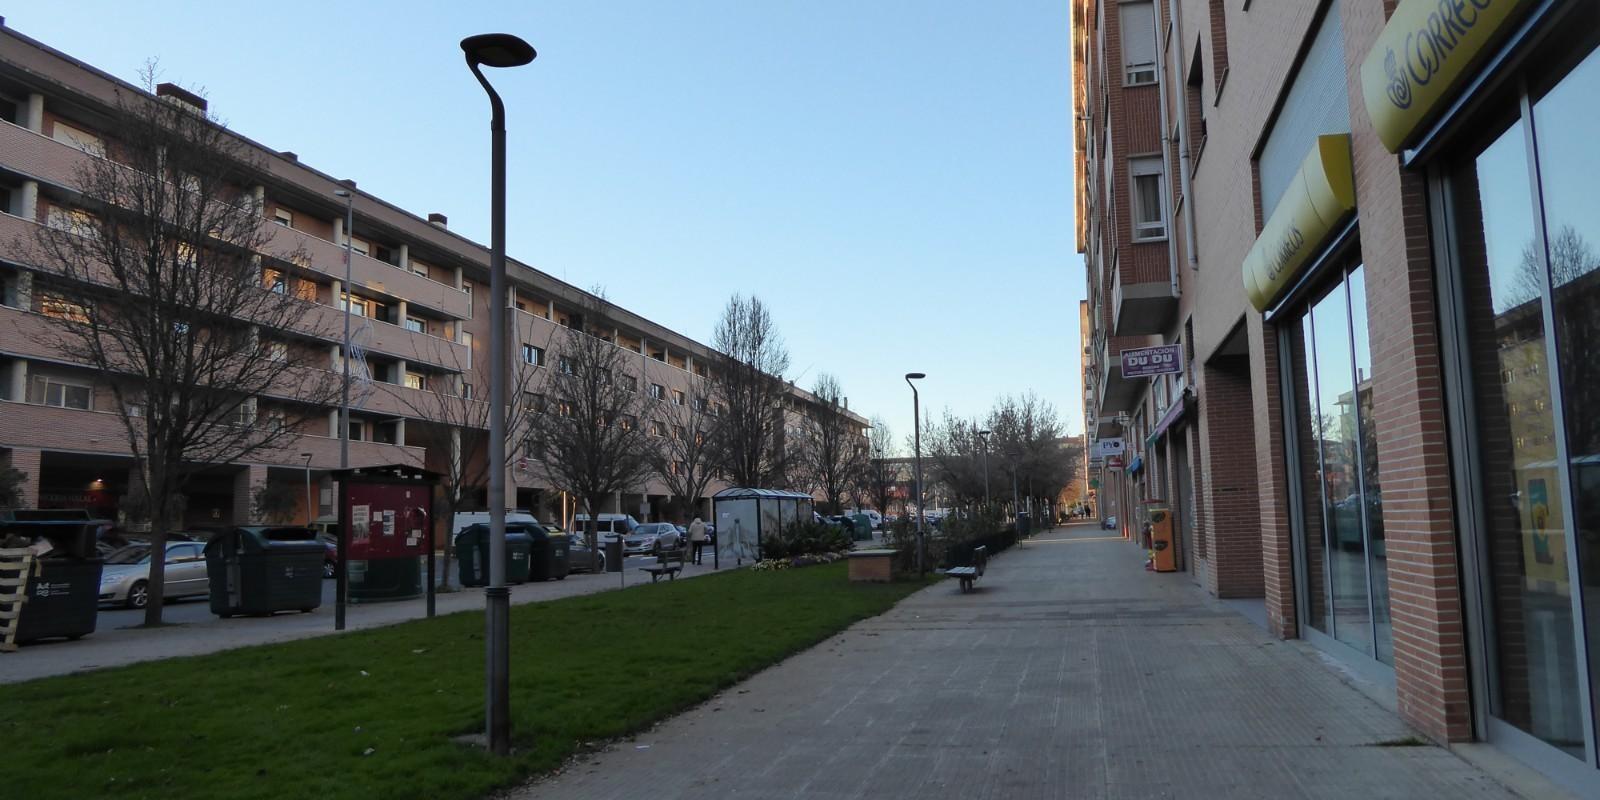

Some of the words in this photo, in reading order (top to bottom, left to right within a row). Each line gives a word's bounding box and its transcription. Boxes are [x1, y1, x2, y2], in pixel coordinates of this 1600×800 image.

[1405, 0, 1490, 86] CORRE
[1128, 357, 1148, 367] DU
[1152, 354, 1172, 364] DU
